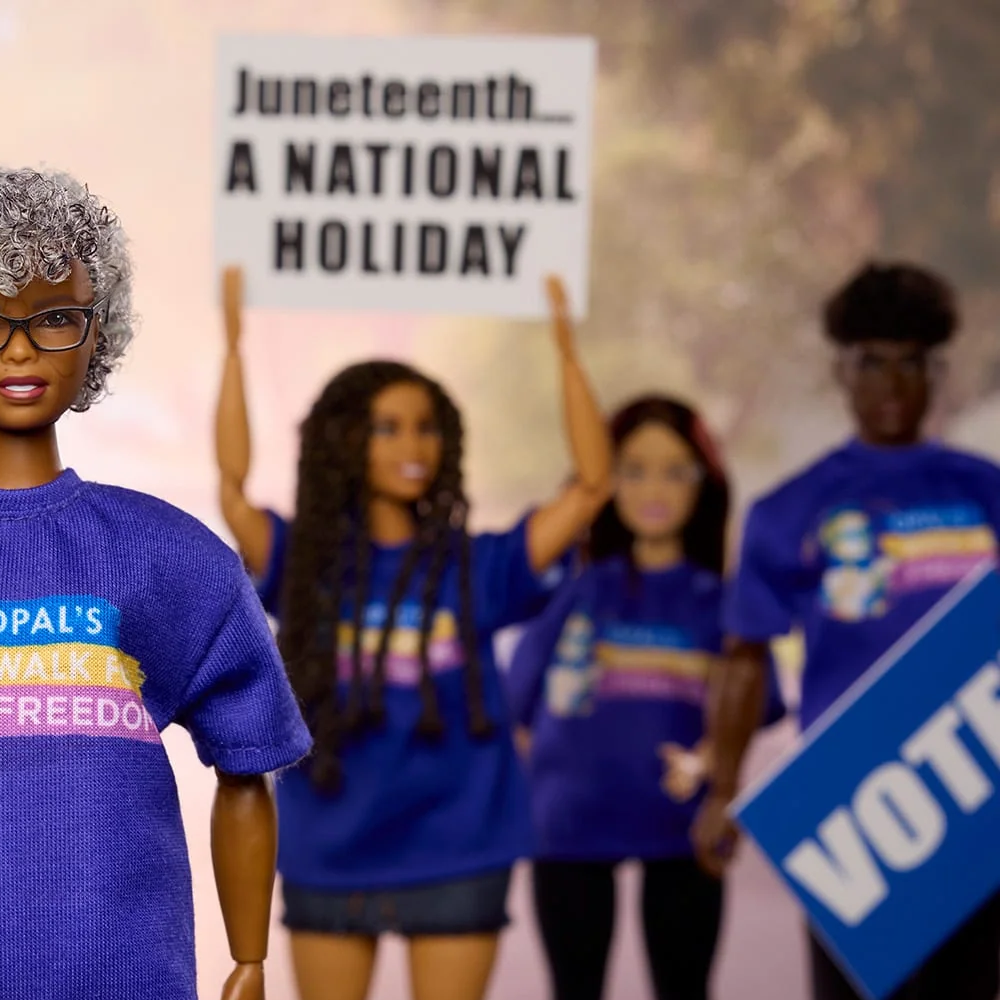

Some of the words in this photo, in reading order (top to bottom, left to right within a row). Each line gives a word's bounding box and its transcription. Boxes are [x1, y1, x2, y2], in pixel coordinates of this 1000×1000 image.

[226, 141, 257, 194] A
[284, 142, 577, 201] NATIONAL
[272, 218, 527, 277] HOLIDAY
